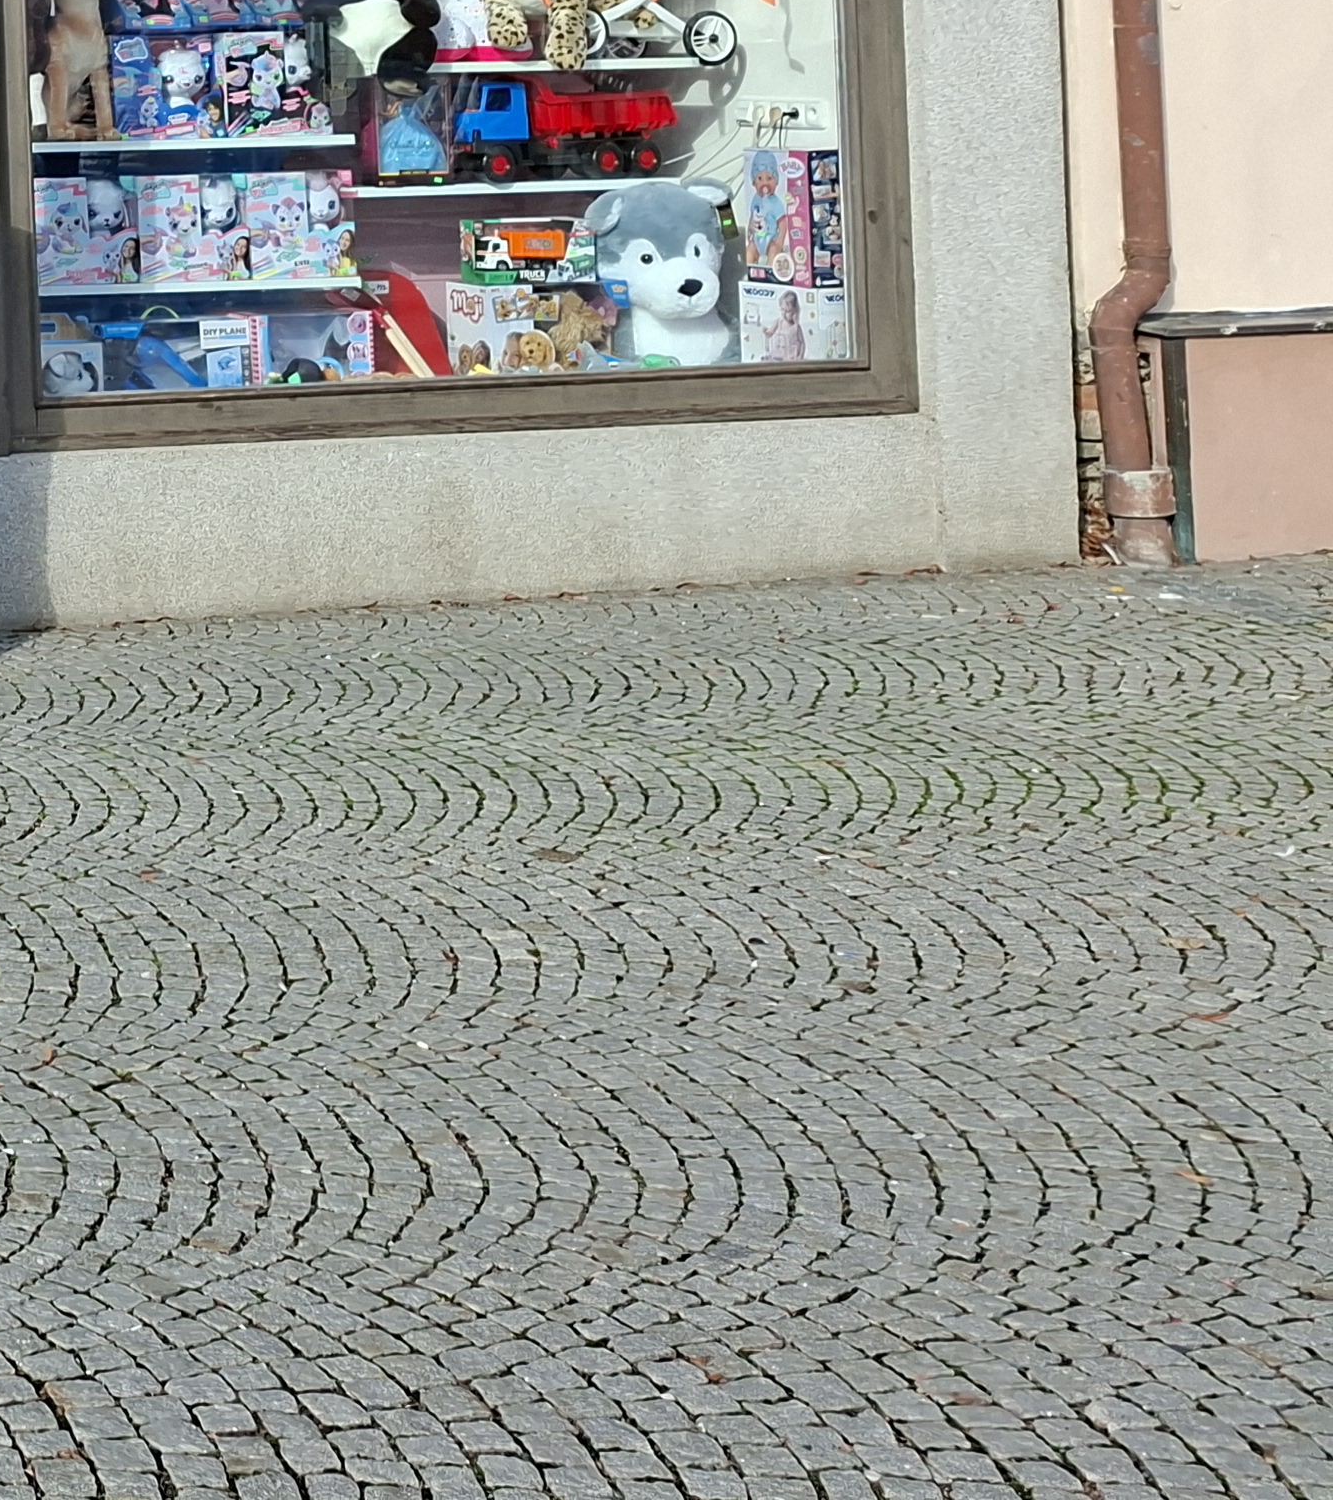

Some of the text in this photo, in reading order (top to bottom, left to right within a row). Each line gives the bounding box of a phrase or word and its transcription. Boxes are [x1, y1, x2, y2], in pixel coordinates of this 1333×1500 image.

[519, 269, 546, 281] TRUCK
[202, 326, 247, 337] DIY PLANE
